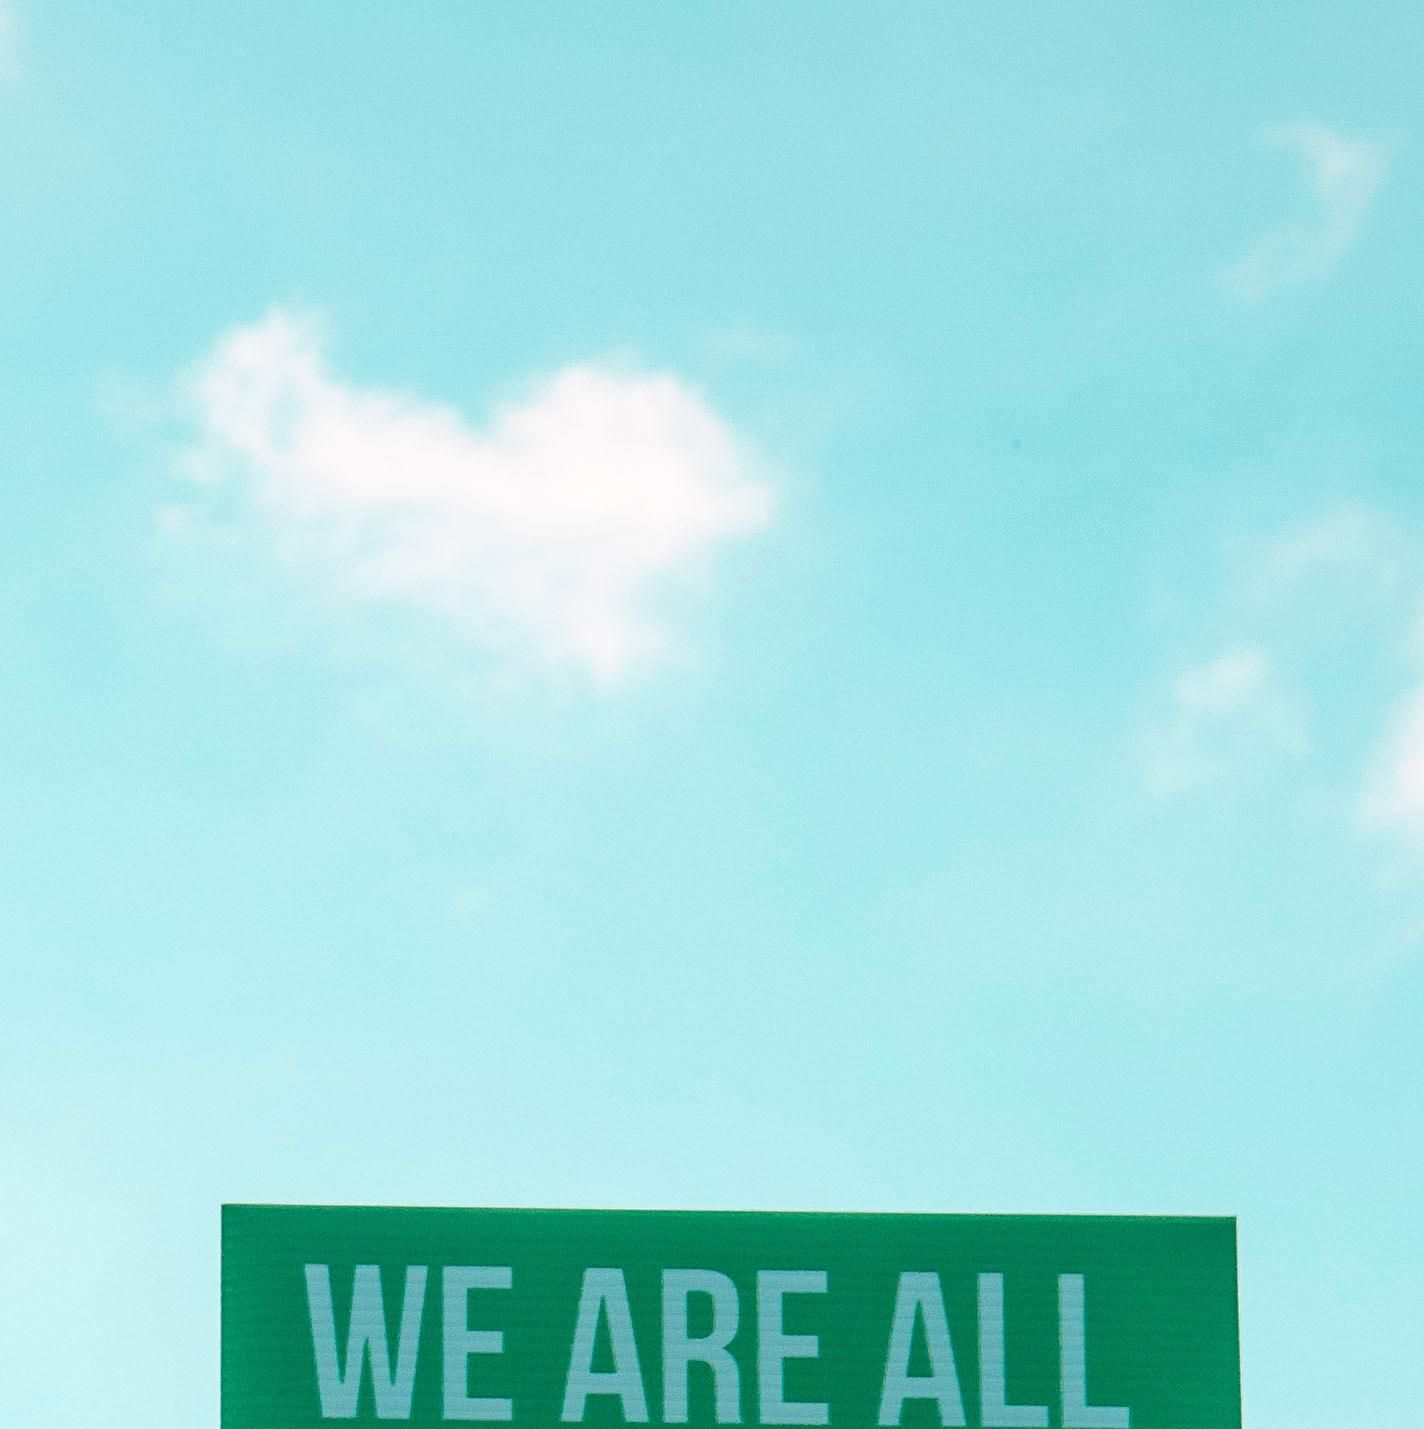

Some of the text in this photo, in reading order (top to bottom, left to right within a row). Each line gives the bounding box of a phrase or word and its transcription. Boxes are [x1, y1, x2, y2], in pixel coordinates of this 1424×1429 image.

[304, 1263, 1131, 1429] WE ARE ALL
